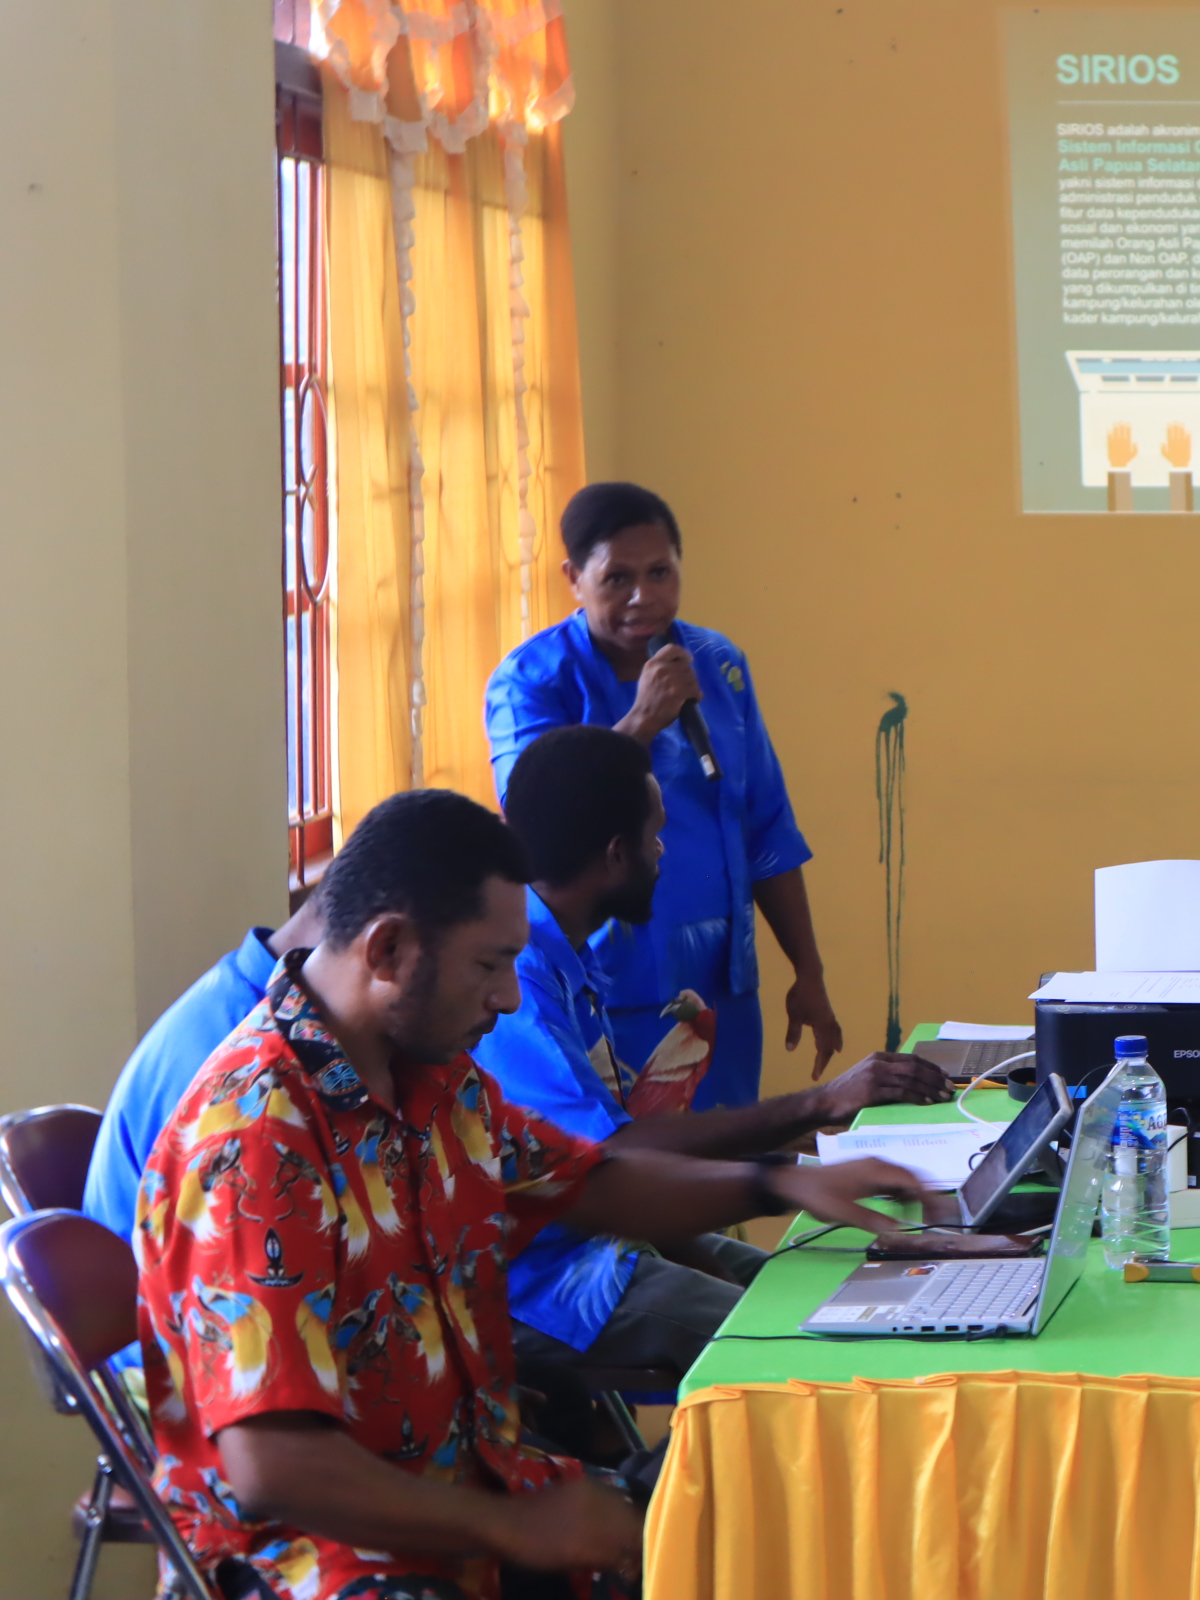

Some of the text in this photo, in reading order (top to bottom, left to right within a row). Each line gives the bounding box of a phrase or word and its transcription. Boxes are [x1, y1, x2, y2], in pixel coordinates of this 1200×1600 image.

[1056, 54, 1180, 84] SIRIOS
[1057, 123, 1104, 136] SIRIOS
[1058, 139, 1112, 154] Sistem
[1116, 139, 1191, 153] Informasi
[1058, 157, 1089, 172] Asli
[1093, 158, 1143, 174] Papua
